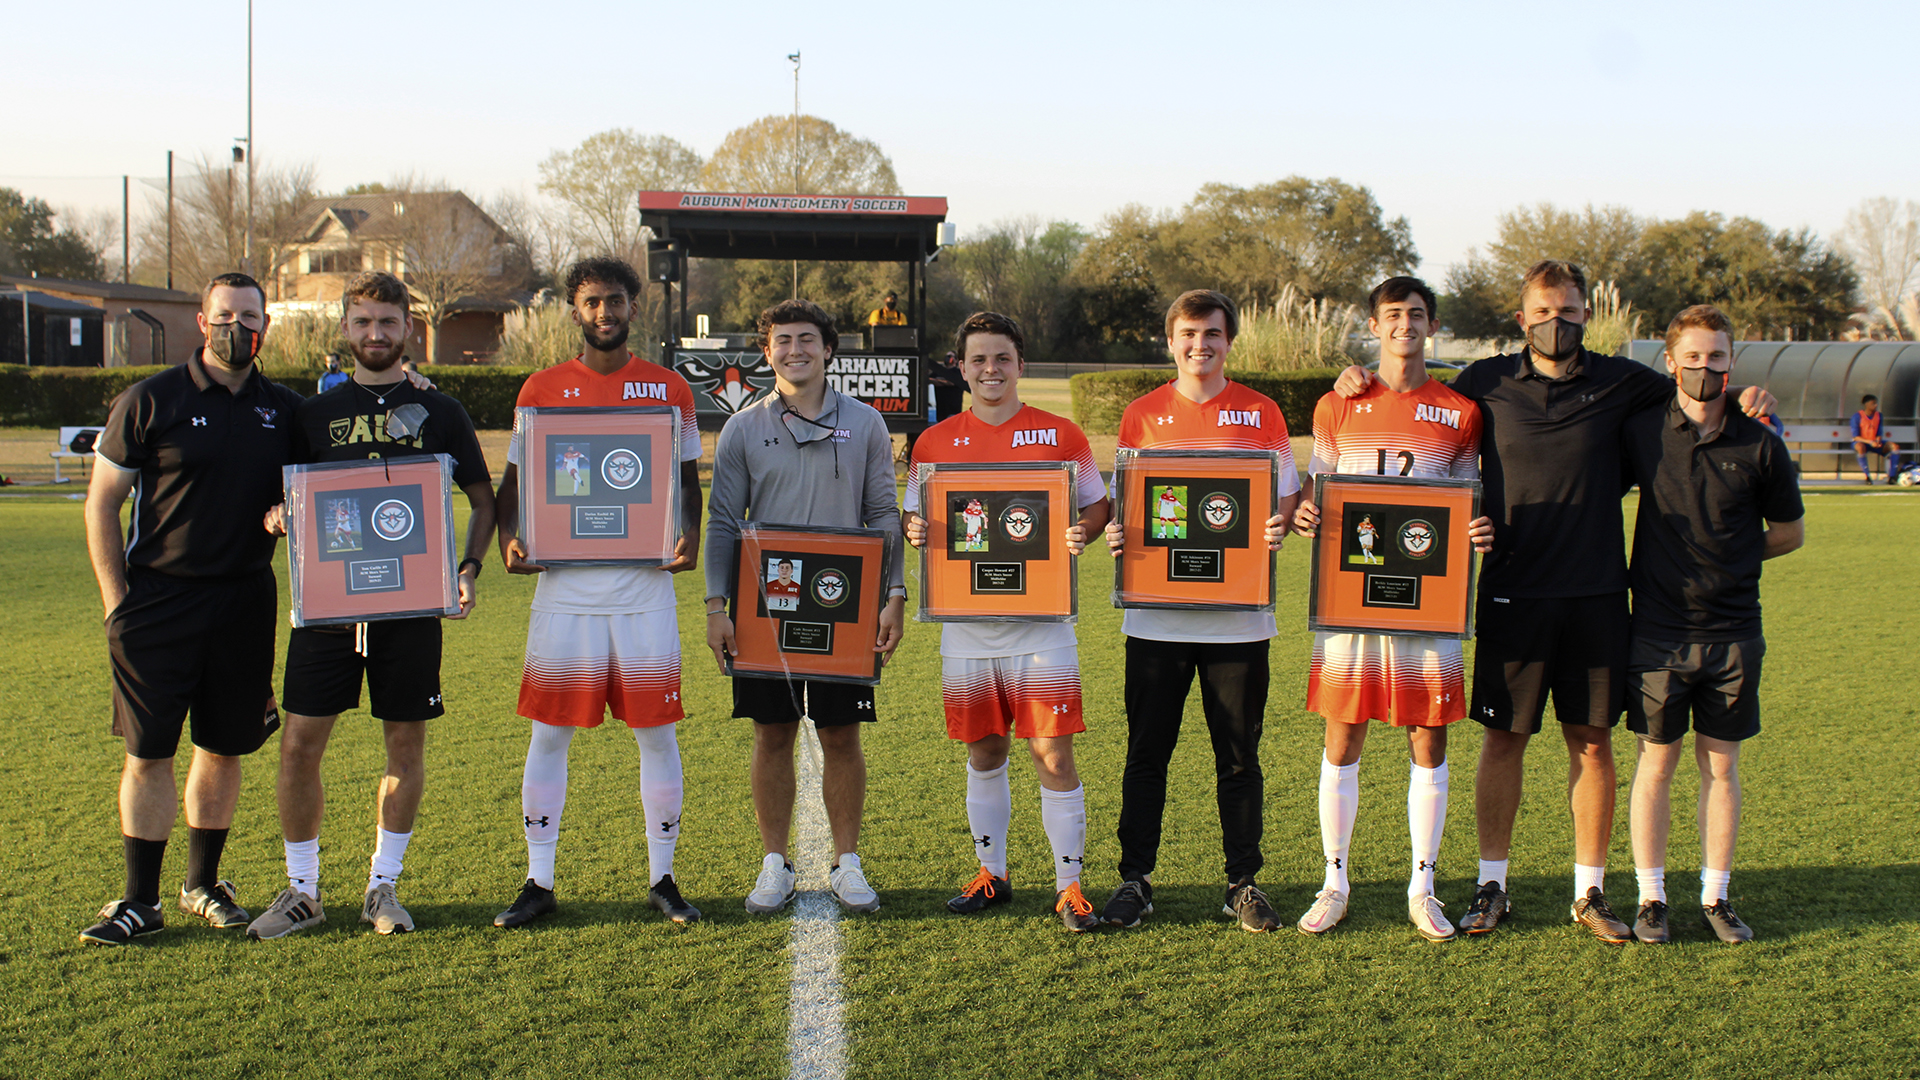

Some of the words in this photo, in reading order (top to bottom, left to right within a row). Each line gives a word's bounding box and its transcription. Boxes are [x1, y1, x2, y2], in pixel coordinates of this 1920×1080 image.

[680, 196, 742, 207] AUBURN
[745, 197, 850, 210] MONTGOMERY
[852, 199, 908, 212] SOCCER
[825, 358, 910, 374] ARHAWK
[622, 381, 668, 402] AUM
[825, 374, 910, 398] OCCER
[1217, 410, 1262, 430] AUM
[1414, 402, 1461, 430] AUM
[1011, 428, 1058, 449] AUM
[779, 598, 788, 607] 13
